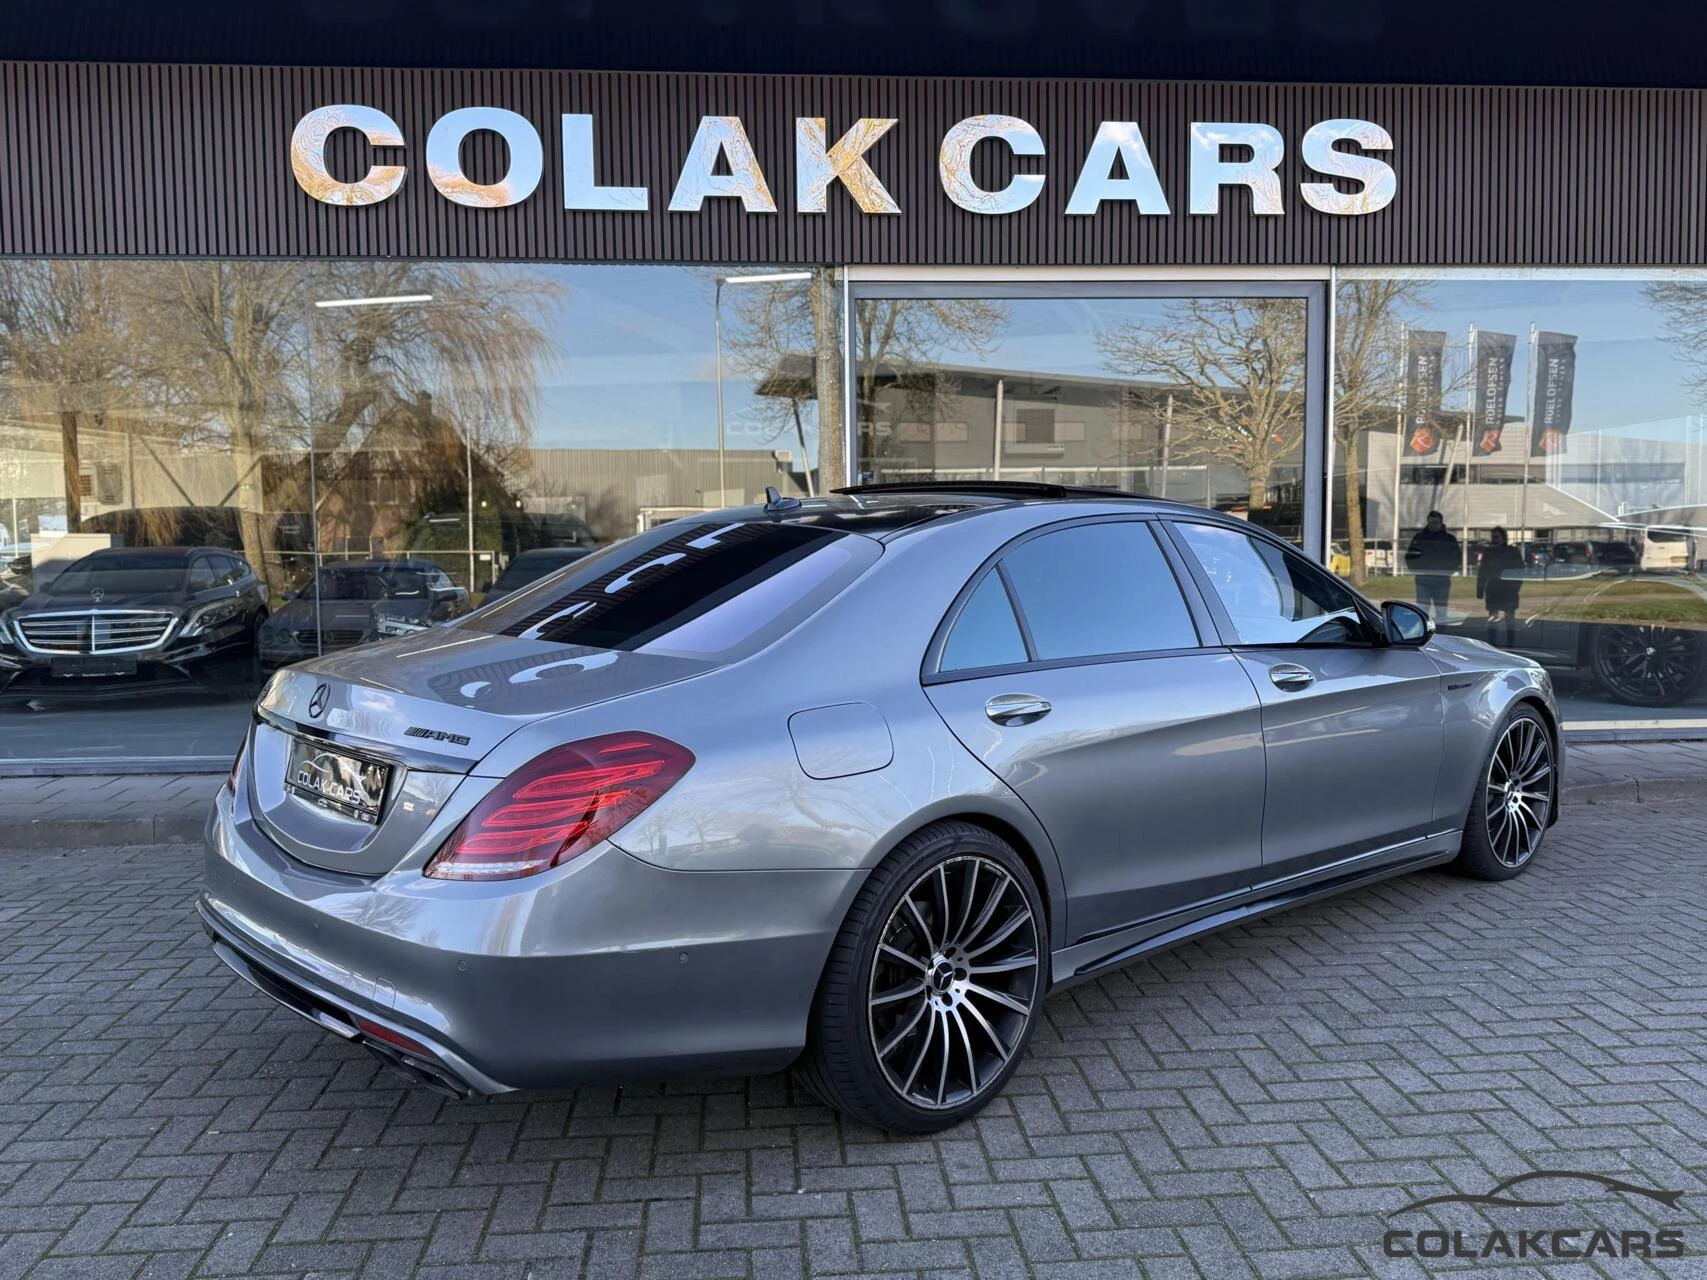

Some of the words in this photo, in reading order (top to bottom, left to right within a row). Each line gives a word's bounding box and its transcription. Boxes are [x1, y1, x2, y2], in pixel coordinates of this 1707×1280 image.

[290, 104, 902, 213] COLAK
[939, 114, 1398, 216] CARS
[1485, 357, 1499, 425] ROELOFSEN
[1544, 358, 1560, 424] ROELOFSEN
[422, 729, 471, 746] AMG
[297, 770, 328, 794] COLAK
[329, 782, 361, 805] CARS
